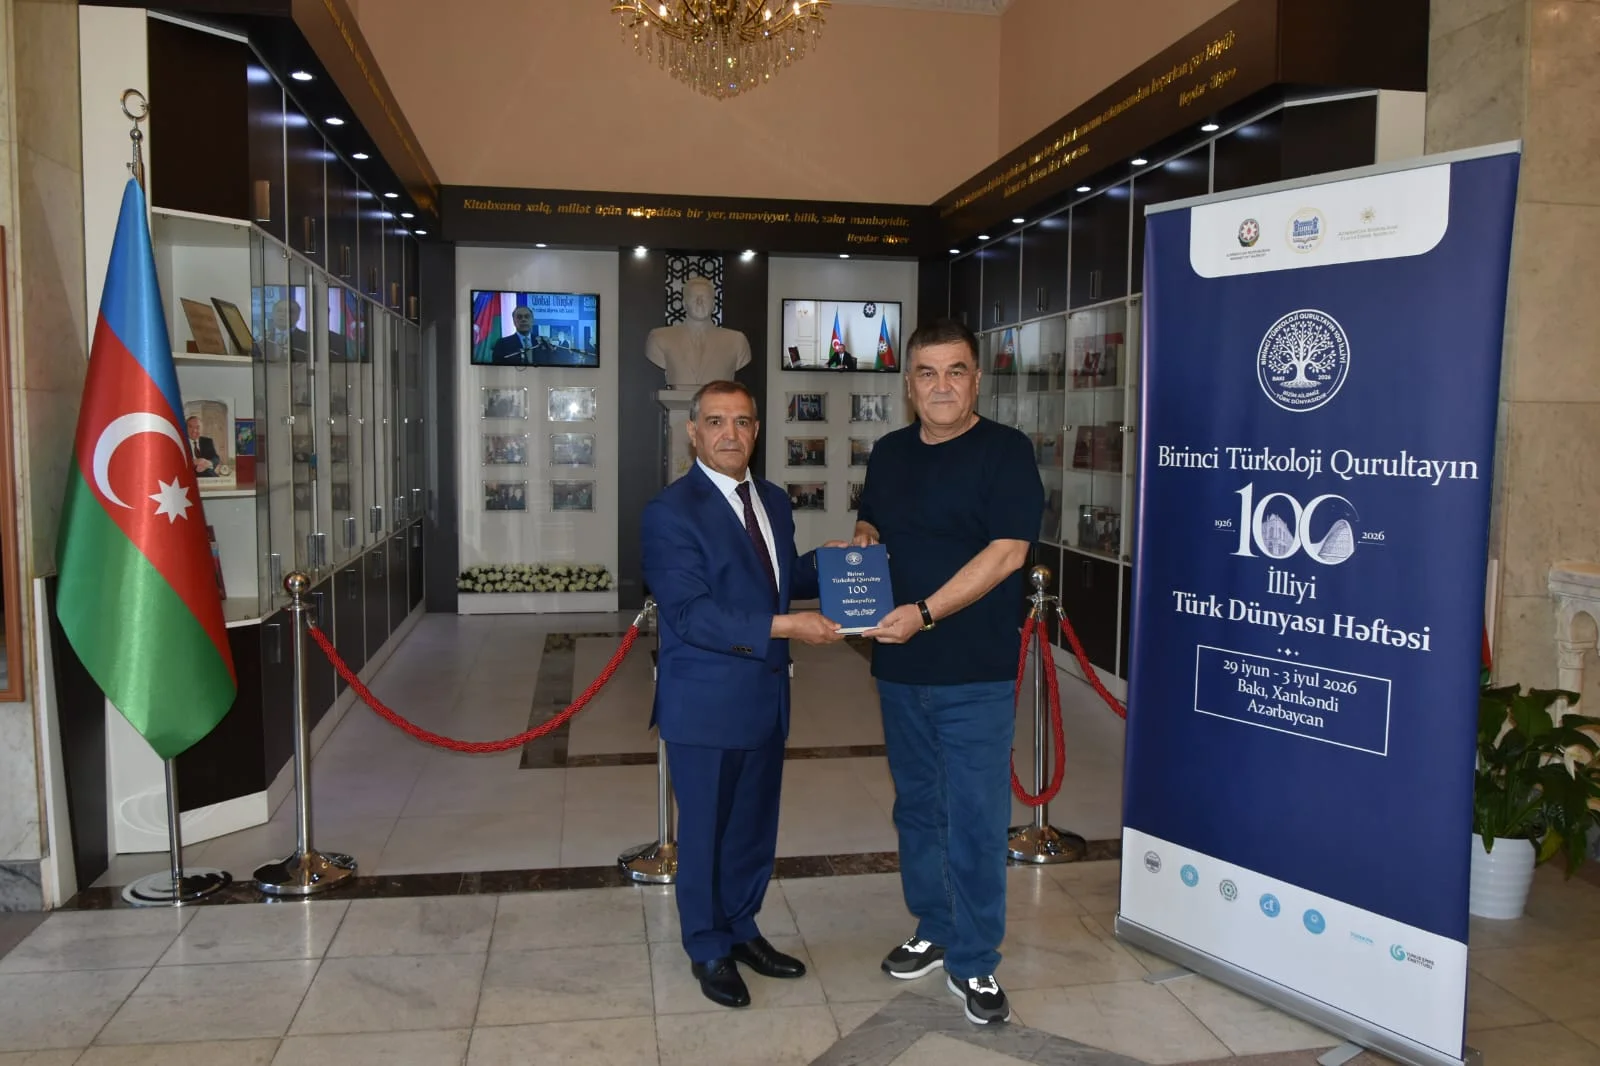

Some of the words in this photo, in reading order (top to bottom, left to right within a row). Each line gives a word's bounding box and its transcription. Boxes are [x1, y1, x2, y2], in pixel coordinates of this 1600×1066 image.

[463, 199, 521, 211] Kitabxana
[557, 203, 591, 214] millət
[594, 205, 622, 217] üçün
[686, 208, 704, 218] bir
[847, 233, 878, 244] Heydər
[1158, 445, 1219, 470] Birinci
[1225, 447, 1322, 480] Türkoloji
[1330, 449, 1479, 486] Qurultayın
[1214, 518, 1232, 528] 1926
[1230, 482, 1360, 566] 100
[1361, 531, 1385, 541] 2026
[848, 585, 868, 594] 100
[1266, 566, 1317, 604] İlliyi
[1172, 590, 1223, 619] Türk
[1228, 599, 1325, 635] Dünyası
[1333, 613, 1431, 652] Həftəsi
[1223, 659, 1238, 674] 29
[1241, 659, 1270, 679] iyun
[1282, 671, 1290, 685] 3
[1293, 668, 1320, 689] iyul
[1323, 677, 1358, 695] 2026
[1237, 678, 1268, 699] Bakı,
[1272, 685, 1339, 713] Xankəndi
[1247, 699, 1324, 728] Azərbaycan
